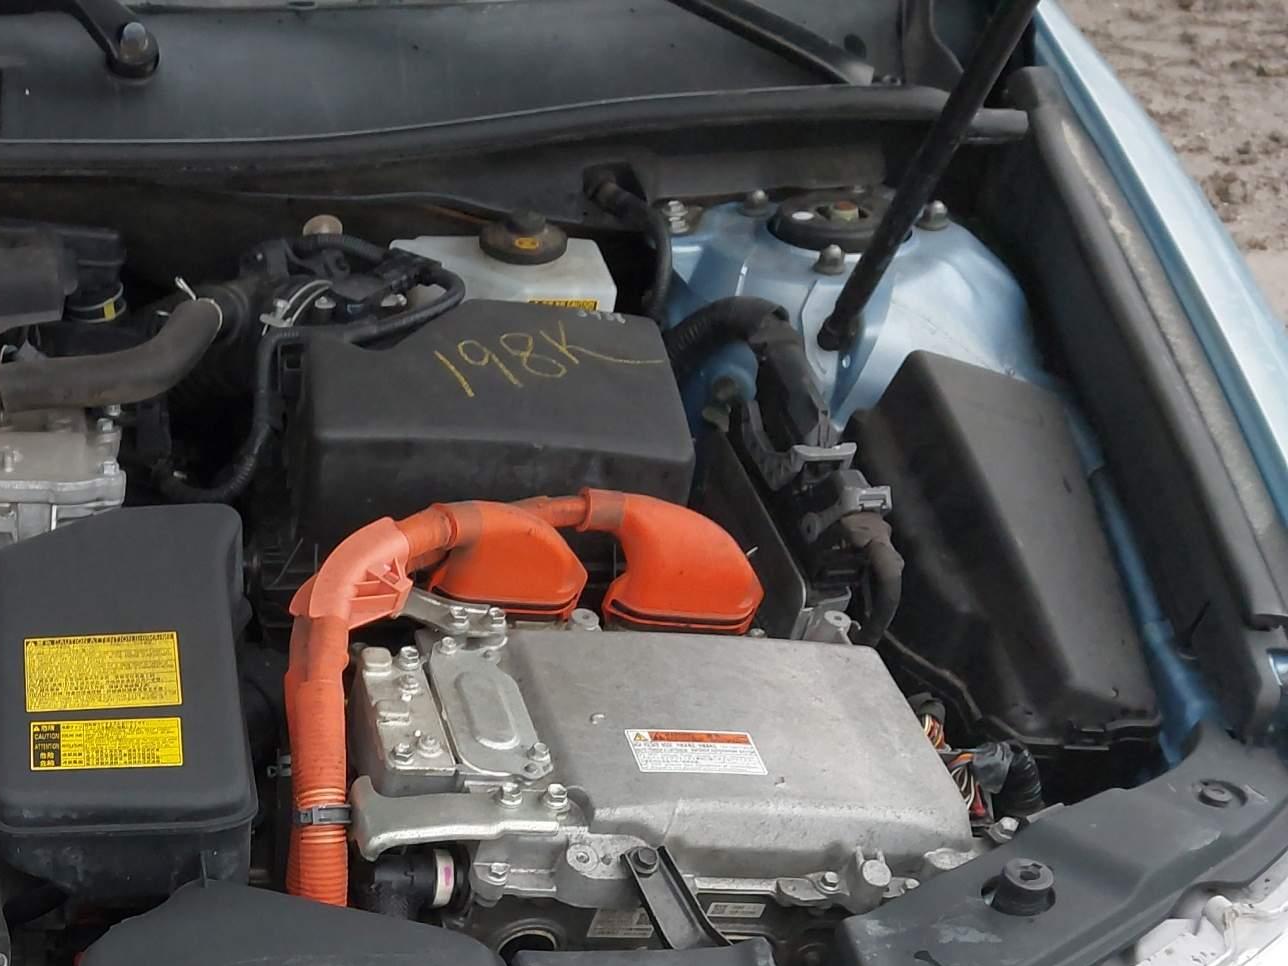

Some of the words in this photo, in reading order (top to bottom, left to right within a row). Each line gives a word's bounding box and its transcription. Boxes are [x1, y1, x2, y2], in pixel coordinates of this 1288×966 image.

[434, 320, 662, 397] 198K
[34, 732, 60, 740] CAUTION
[34, 742, 60, 750] ATTENTION
